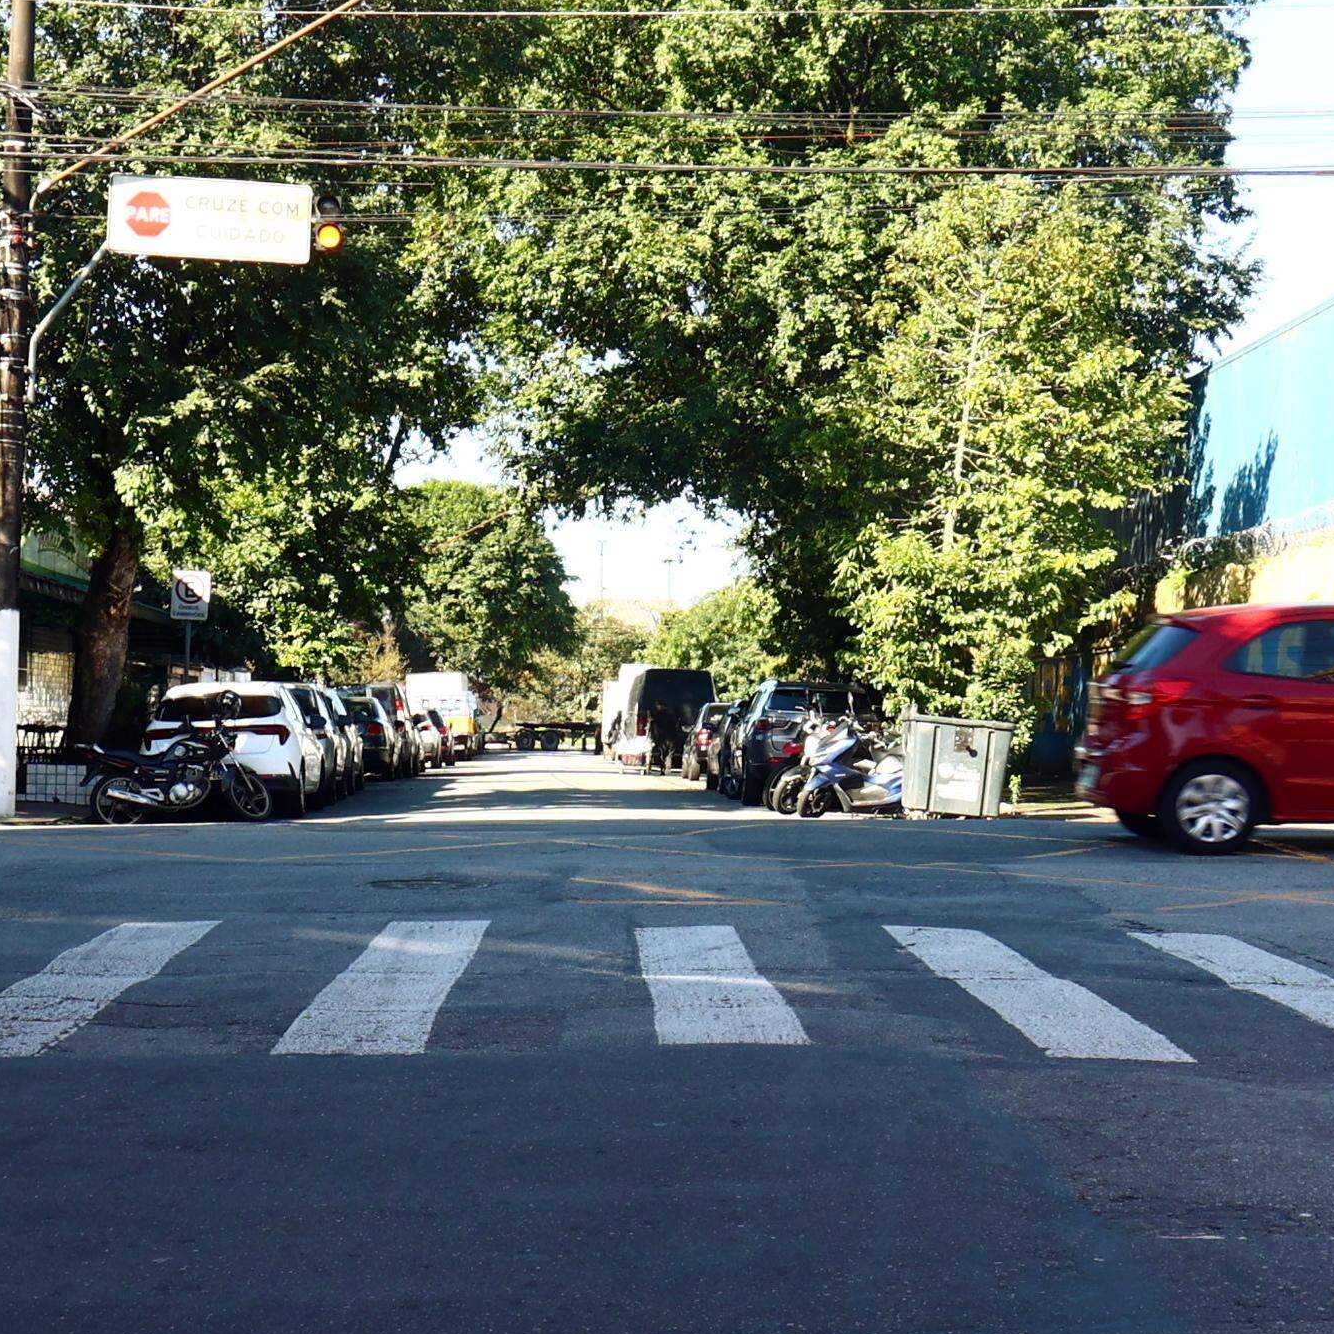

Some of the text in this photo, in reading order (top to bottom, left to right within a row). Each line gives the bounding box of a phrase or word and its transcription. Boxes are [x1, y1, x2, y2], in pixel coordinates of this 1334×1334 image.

[127, 205, 171, 223] PARE
[185, 195, 300, 218] CRUZE COM
[196, 225, 286, 244] CUIDADO
